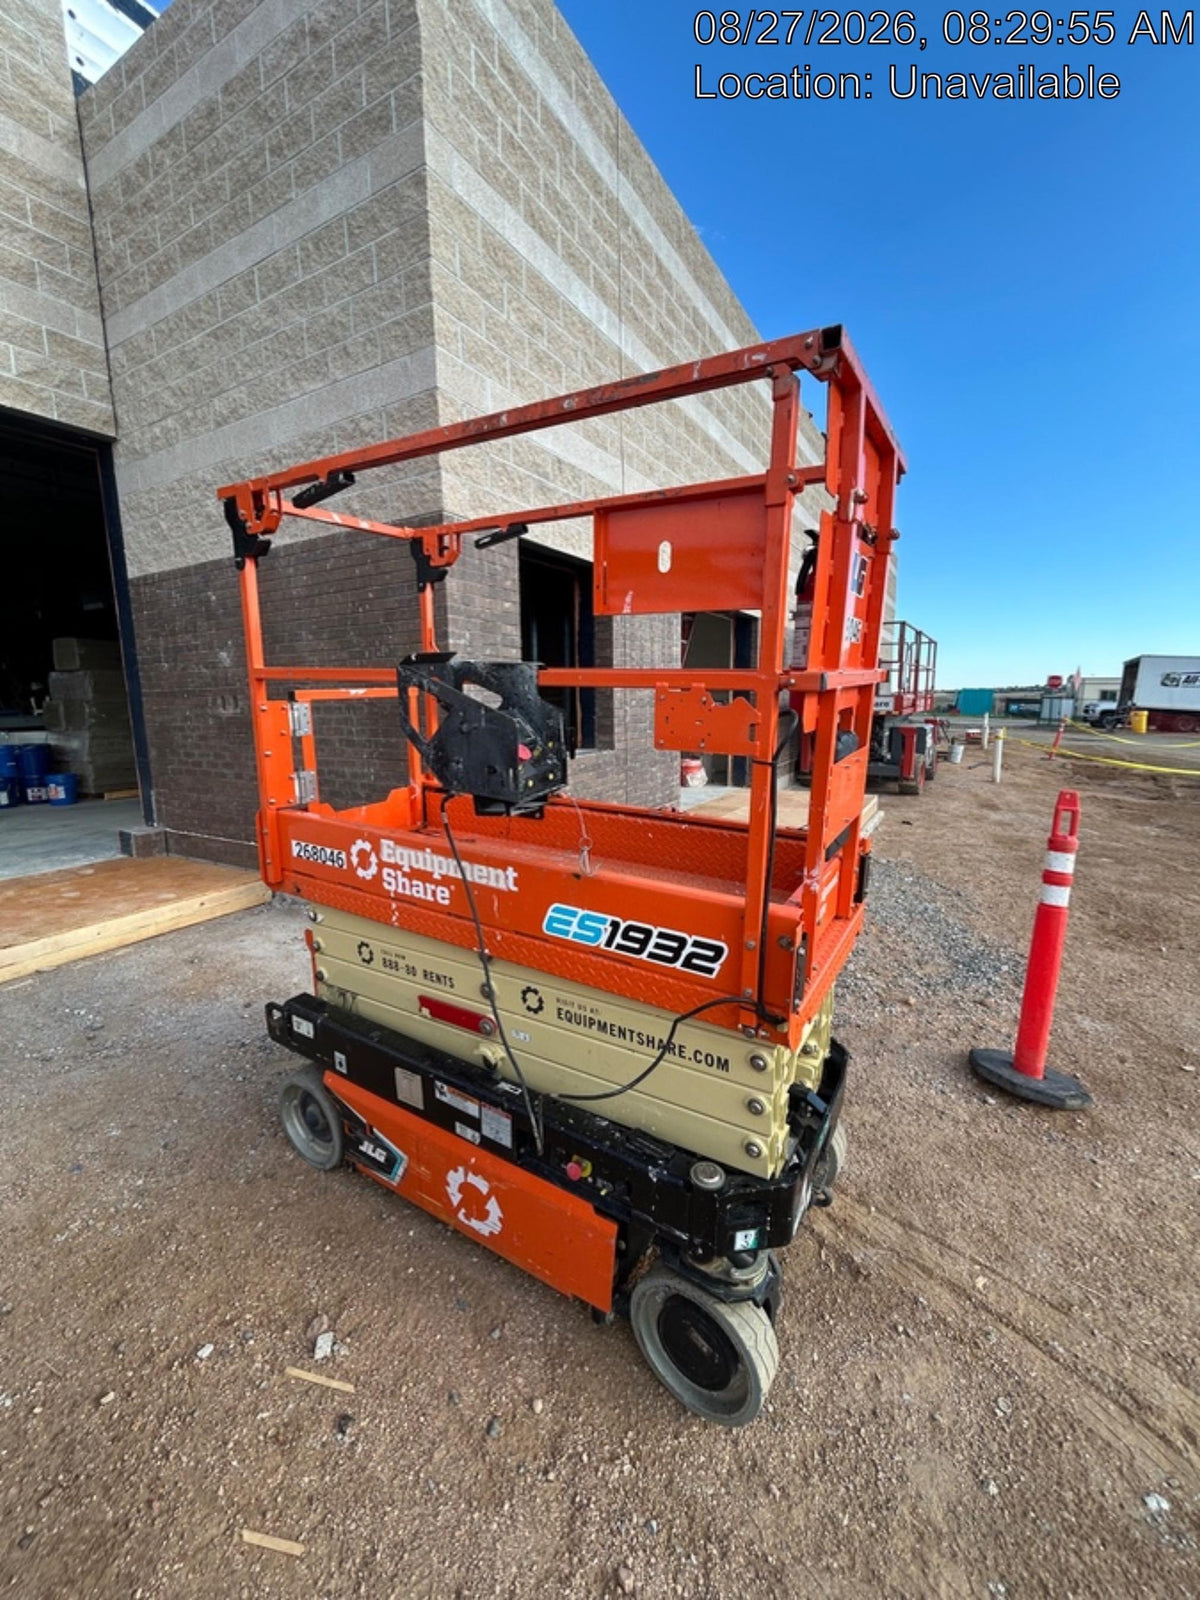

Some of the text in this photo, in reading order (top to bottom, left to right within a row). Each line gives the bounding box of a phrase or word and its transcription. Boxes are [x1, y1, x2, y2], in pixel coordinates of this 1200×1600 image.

[294, 842, 344, 869] 268046
[380, 838, 518, 892] Equipment
[382, 868, 450, 905] Share
[543, 904, 728, 977] ES1932
[422, 968, 455, 989] RENTS
[557, 1007, 730, 1072] EQUIPMENTSHARE.COM
